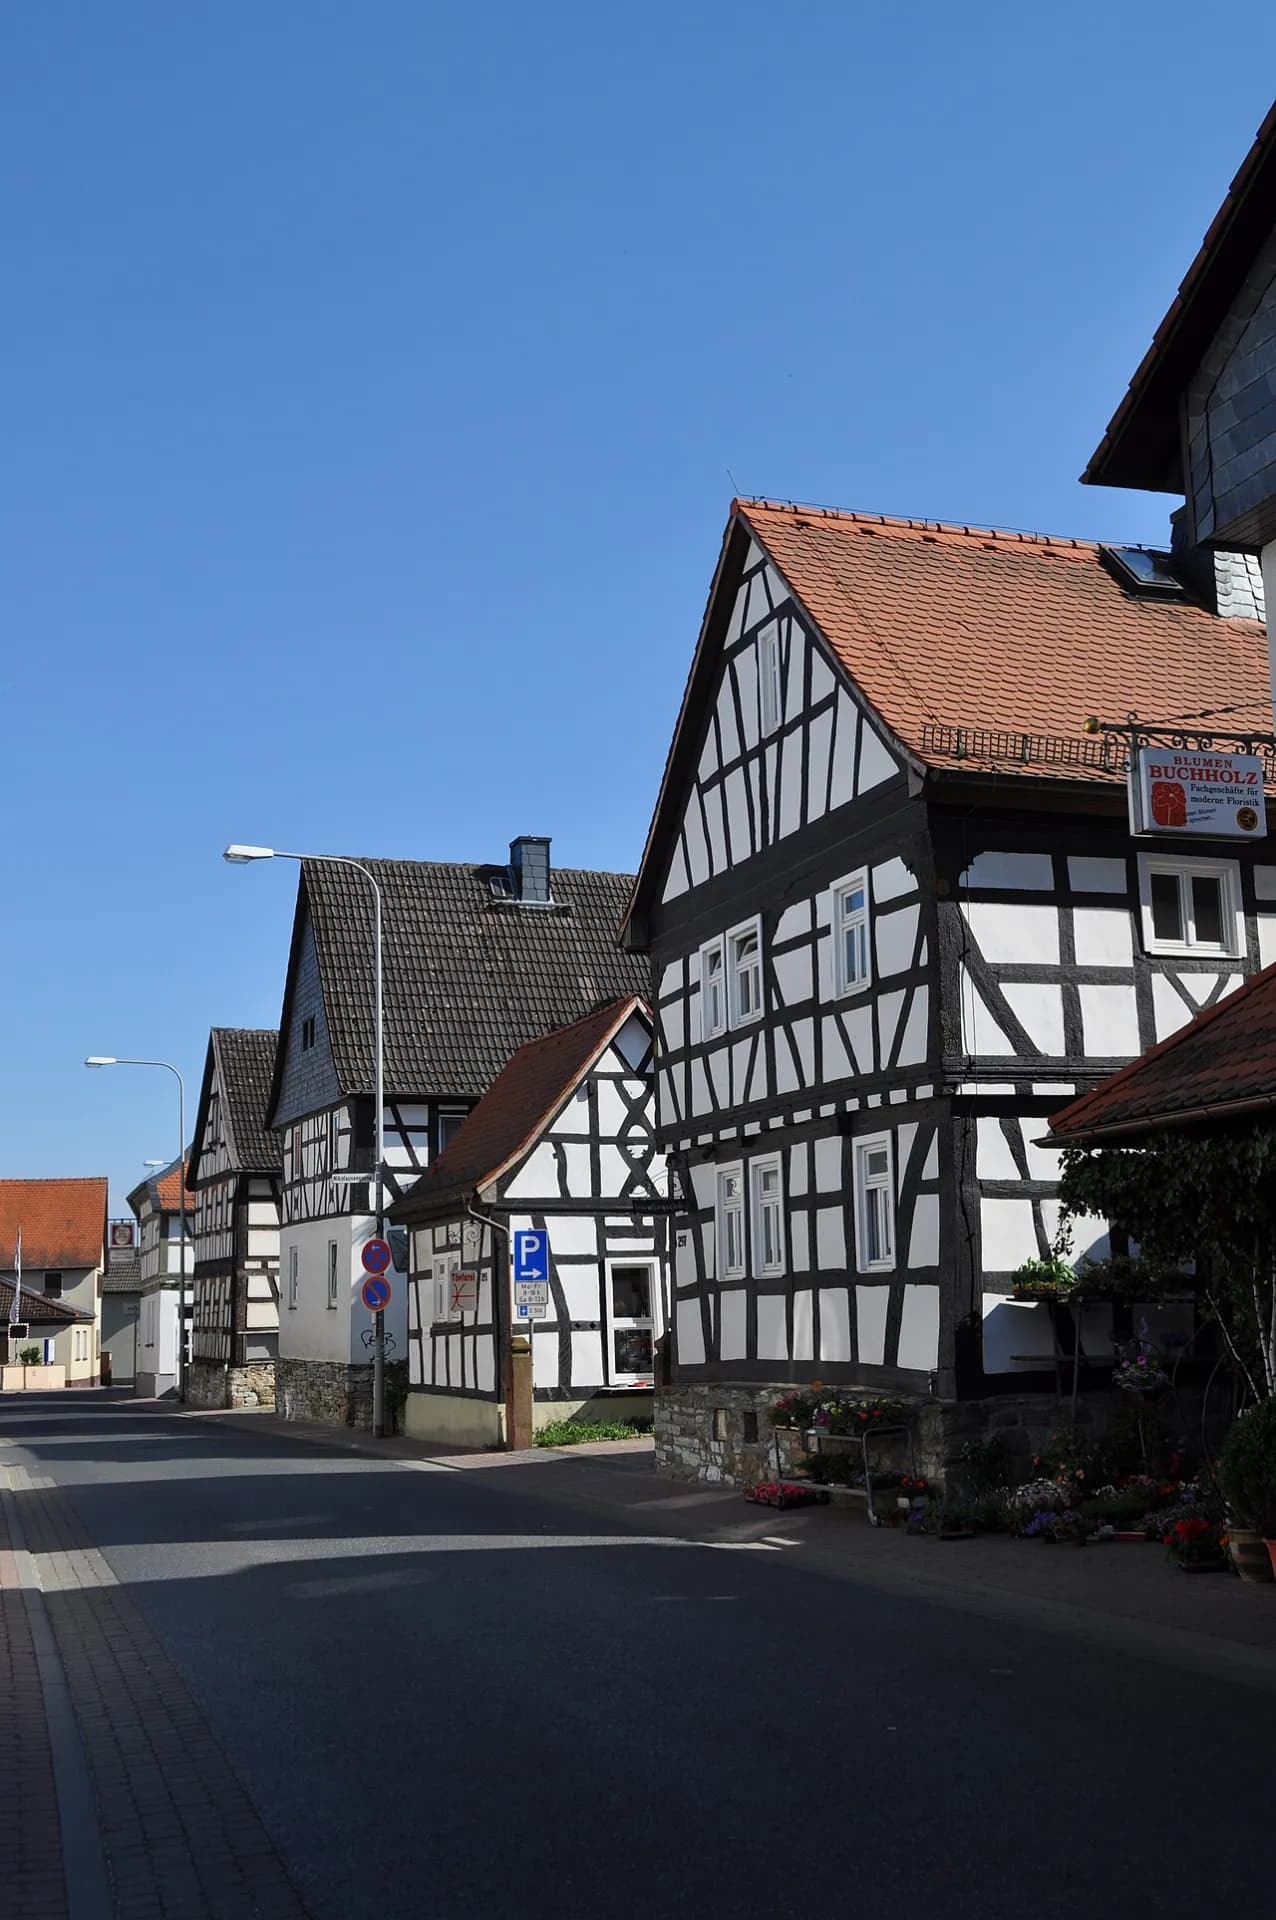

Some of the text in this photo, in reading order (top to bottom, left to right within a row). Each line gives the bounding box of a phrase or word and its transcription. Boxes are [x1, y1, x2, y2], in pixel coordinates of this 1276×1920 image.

[1174, 756, 1233, 768] BLUMEN
[1148, 765, 1258, 785] BUCHHOLZ
[1190, 784, 1244, 795] Fachgeschäfte
[1190, 796, 1260, 807] moderne Floristik
[520, 1235, 540, 1266] P
